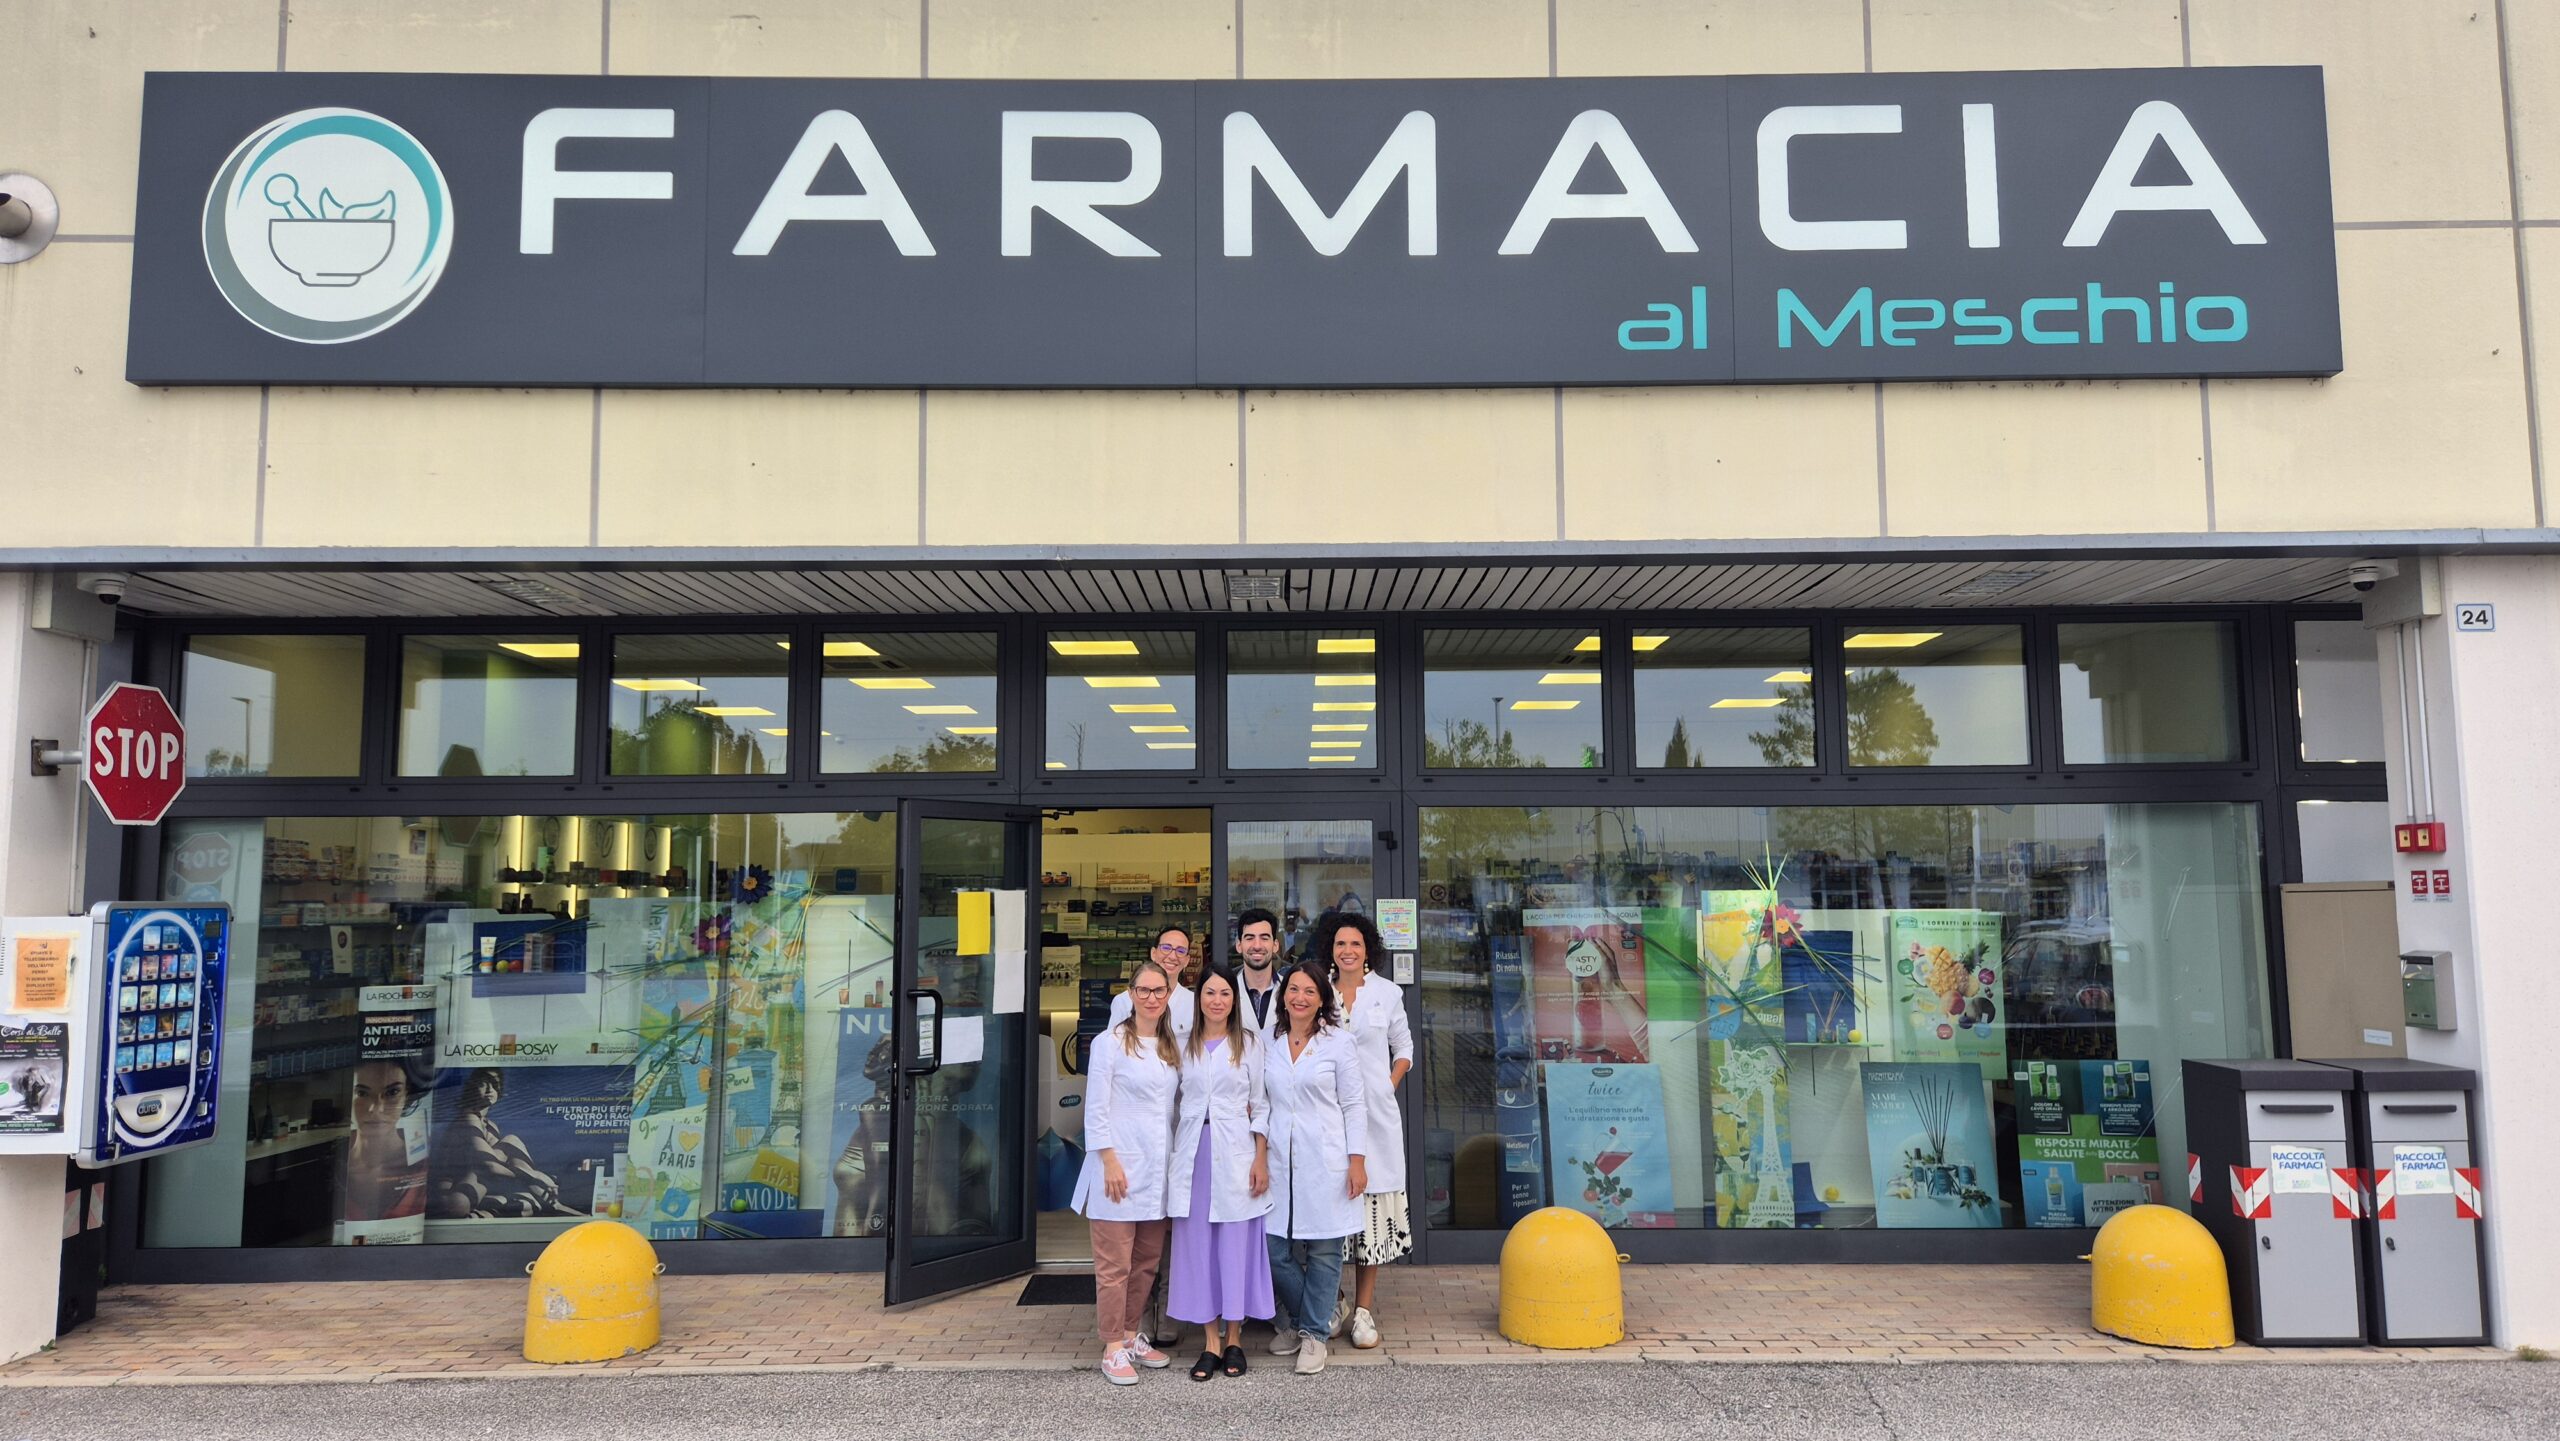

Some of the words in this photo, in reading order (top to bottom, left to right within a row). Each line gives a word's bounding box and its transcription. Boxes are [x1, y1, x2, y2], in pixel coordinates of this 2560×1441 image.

[519, 100, 2268, 258] FARMACIA
[1617, 286, 1708, 350] al
[1777, 281, 2249, 349] Meschio
[2461, 609, 2489, 625] 24
[95, 726, 180, 780] STOP
[366, 993, 378, 1001] LA
[363, 1024, 432, 1036] ANTHELIOS
[362, 1036, 380, 1047] UV
[444, 1045, 462, 1057] LA
[463, 1043, 512, 1056] ROCHE
[515, 1043, 559, 1056] POSAY
[1588, 1081, 1623, 1096] twice
[139, 1102, 162, 1115] durex
[546, 1106, 555, 1114] IL
[556, 1106, 590, 1114] FILTRO
[851, 1104, 875, 1112] ALTA
[952, 1103, 994, 1112] DORATA
[1569, 1106, 1611, 1115] L'equilibrio
[1612, 1106, 1644, 1114] naturale
[563, 1113, 602, 1121] CONTRO
[2035, 1138, 2086, 1149] RISPOSTE
[2089, 1139, 2131, 1149] MIRATE
[2043, 1148, 2085, 1159] SALUTE
[2098, 1149, 2139, 1160] BOCCA
[2272, 1152, 2325, 1160] RACCOLTA
[2395, 1152, 2447, 1161] RACCOLTA
[658, 1151, 696, 1169] PARIS
[2279, 1161, 2323, 1170] FARMACI
[2402, 1161, 2446, 1170] FARMACI
[1511, 1183, 1522, 1191] Per
[745, 1187, 797, 1211] MODE
